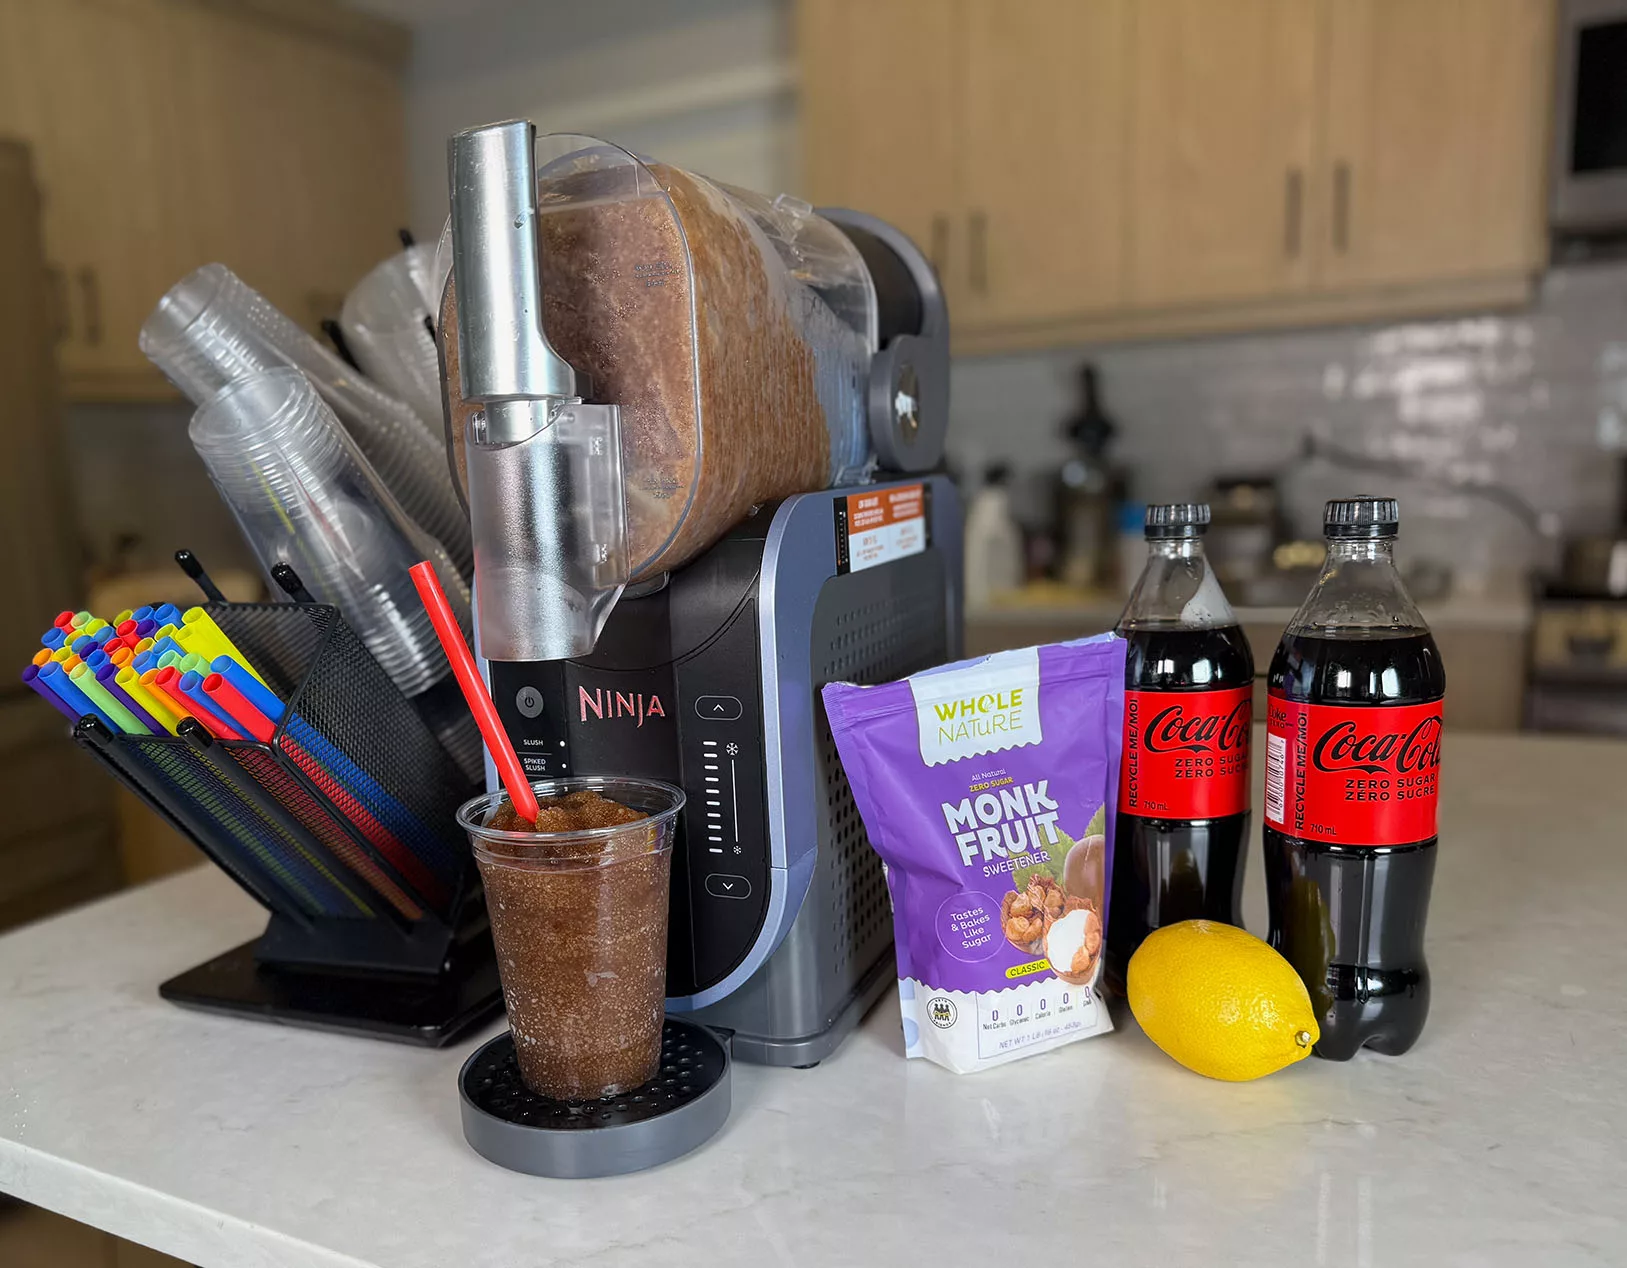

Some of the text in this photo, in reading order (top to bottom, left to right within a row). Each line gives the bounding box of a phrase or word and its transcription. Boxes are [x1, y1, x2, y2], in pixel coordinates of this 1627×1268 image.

[578, 685, 666, 728] NINJA
[934, 688, 1023, 722] WHOLE
[1143, 699, 1252, 754] Coca-Co
[1312, 715, 1442, 775] Coca-Col
[1129, 699, 1139, 808] RECYCLE ME/MOI
[1175, 757, 1214, 767] ZERO
[971, 768, 1007, 781] All Natural
[1175, 767, 1214, 778] ZÉRO
[1295, 712, 1308, 830] RECYCLE ME/MOI
[969, 777, 1014, 792] ZERO SUGAR
[1345, 773, 1435, 789] ZERO SUGAR
[1345, 784, 1435, 801] ZÉRO SUCRE
[941, 779, 1059, 834] MONK
[1143, 801, 1169, 811] 710 mL
[1310, 823, 1337, 836] 710 mL
[955, 810, 1059, 867] FRUIT
[982, 850, 1051, 877] SWEETENER
[950, 907, 984, 921] Tastes
[951, 914, 990, 932] & Bakes
[963, 926, 985, 939] Like
[961, 933, 992, 949] Sugar
[1010, 961, 1045, 976] CLASSIC
[1040, 998, 1046, 1010] 0
[1063, 992, 1069, 1004] 0
[992, 1009, 999, 1022] 0
[1016, 1004, 1023, 1016] 0
[999, 1039, 1012, 1049] NET
